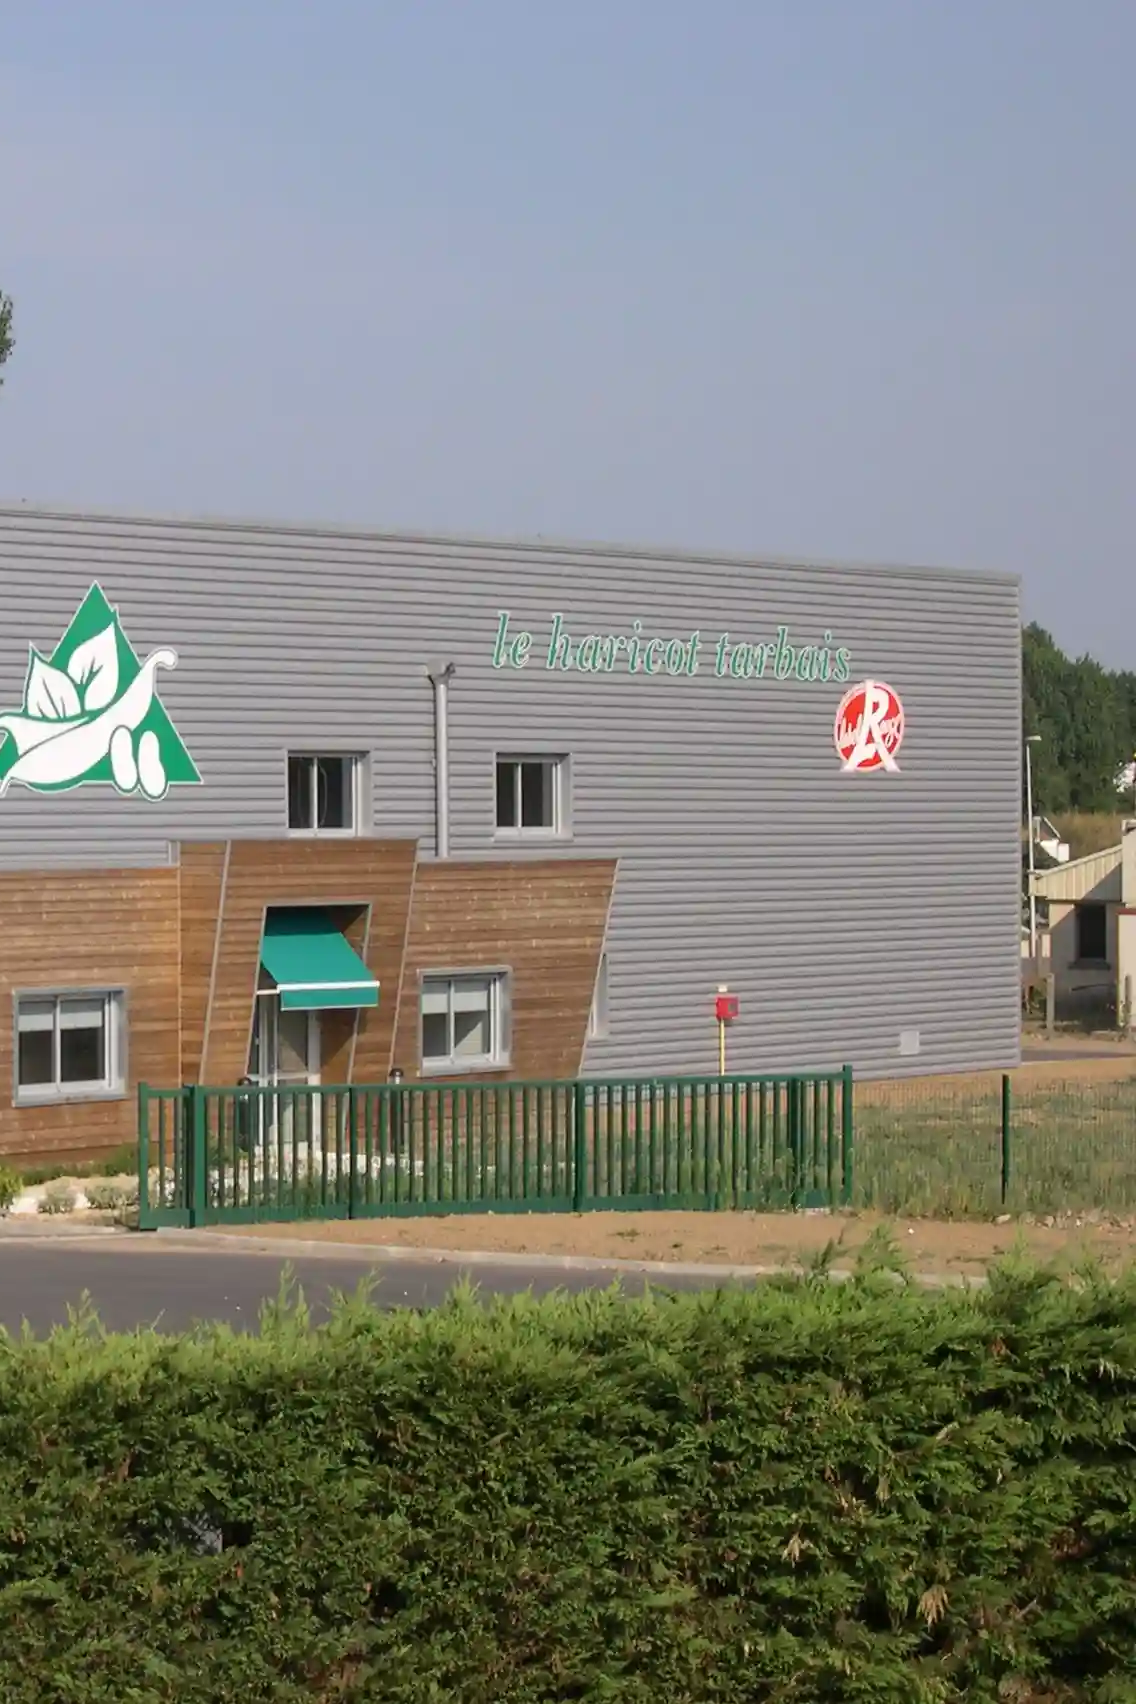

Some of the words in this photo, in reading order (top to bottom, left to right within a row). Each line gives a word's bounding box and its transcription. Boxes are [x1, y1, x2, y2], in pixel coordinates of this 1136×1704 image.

[493, 611, 532, 669] le
[547, 613, 702, 675] haricot
[714, 625, 852, 682] tarbais
